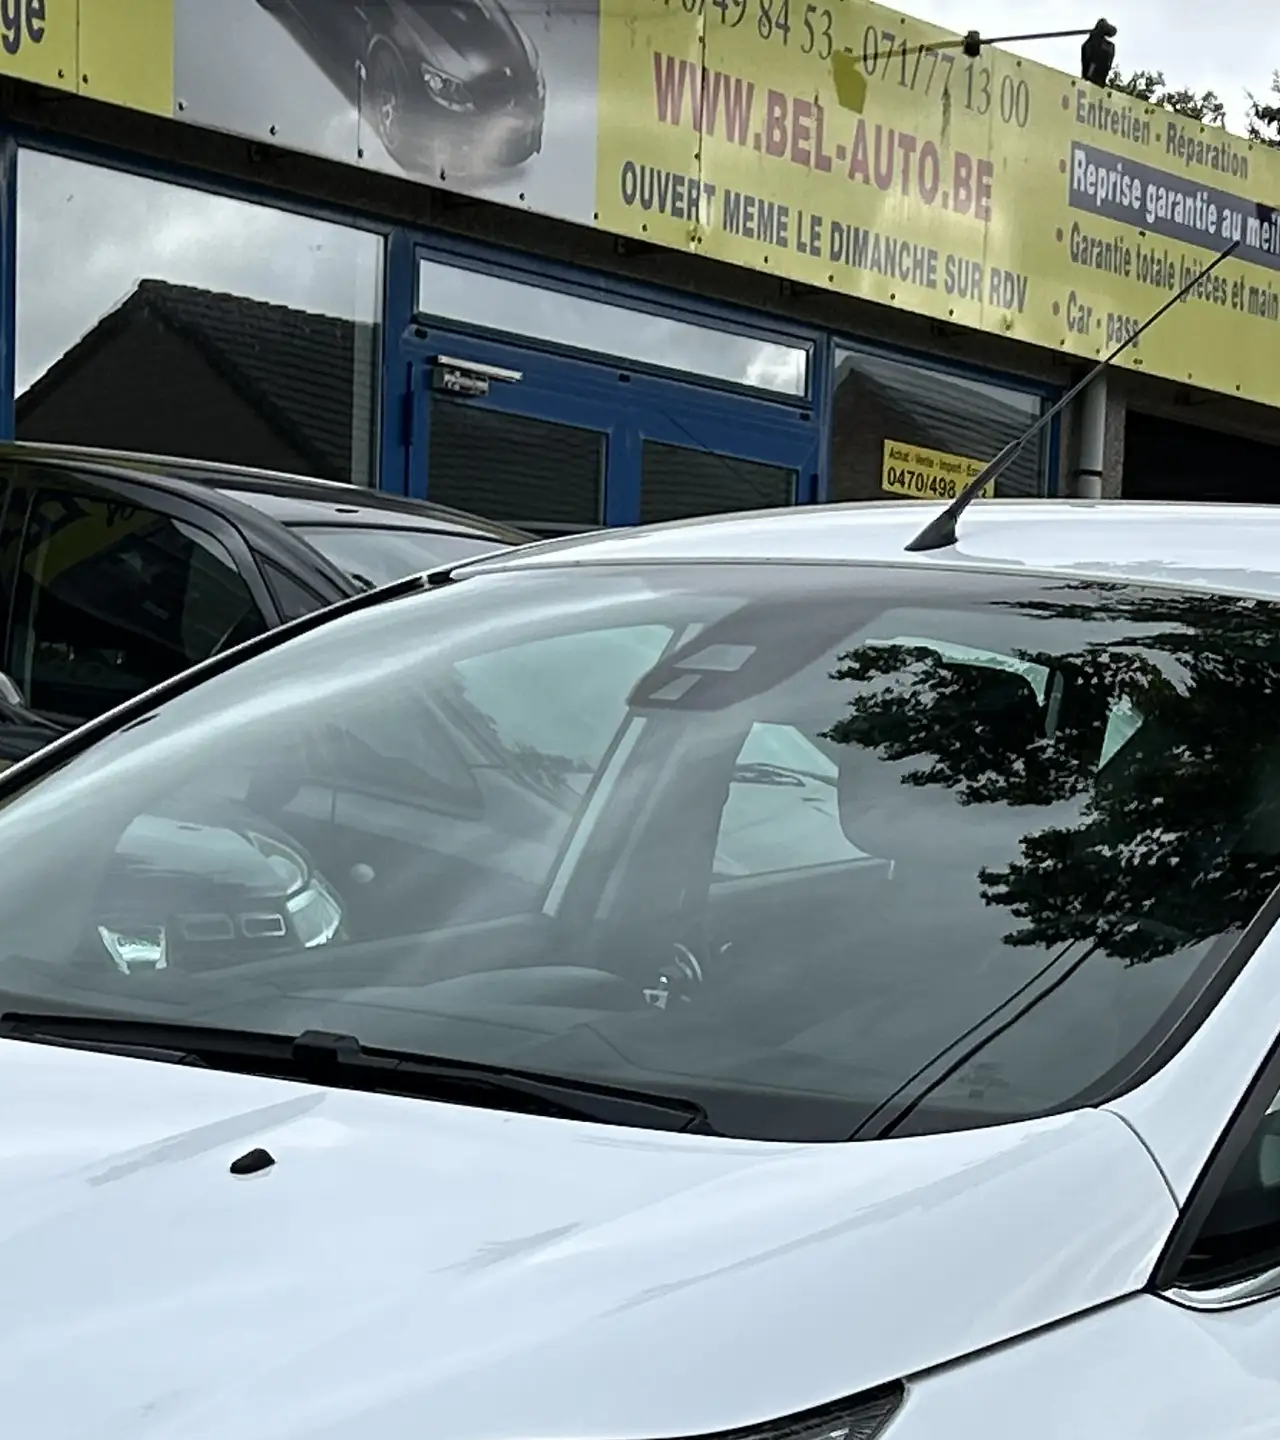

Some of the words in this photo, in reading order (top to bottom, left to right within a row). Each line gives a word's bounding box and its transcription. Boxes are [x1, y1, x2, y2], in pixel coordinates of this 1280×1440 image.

[800, 4, 833, 60] 53
[863, 26, 955, 100] 071/77
[963, 64, 991, 115] 13
[1000, 75, 1029, 128] 00
[653, 52, 995, 223] WWW.BEL-AUTO.BE
[1076, 89, 1150, 145] Entretien
[1166, 121, 1248, 180] Réparation
[621, 161, 716, 228] OUVERT
[723, 189, 789, 248] MEME
[797, 210, 822, 258] LE
[829, 221, 938, 290] DIMANCHE
[944, 254, 983, 303] SUR
[989, 267, 1028, 313] RDV
[1073, 149, 1142, 207] Reprise
[1146, 183, 1217, 234] garantie
[1222, 208, 1242, 241] au
[1070, 221, 1132, 277] Garantie
[1136, 244, 1175, 291] totale
[1232, 274, 1245, 311] et
[1248, 281, 1278, 321] main
[1067, 290, 1092, 335] Car
[1106, 312, 1140, 349] pass
[886, 465, 957, 499] 0470/498
